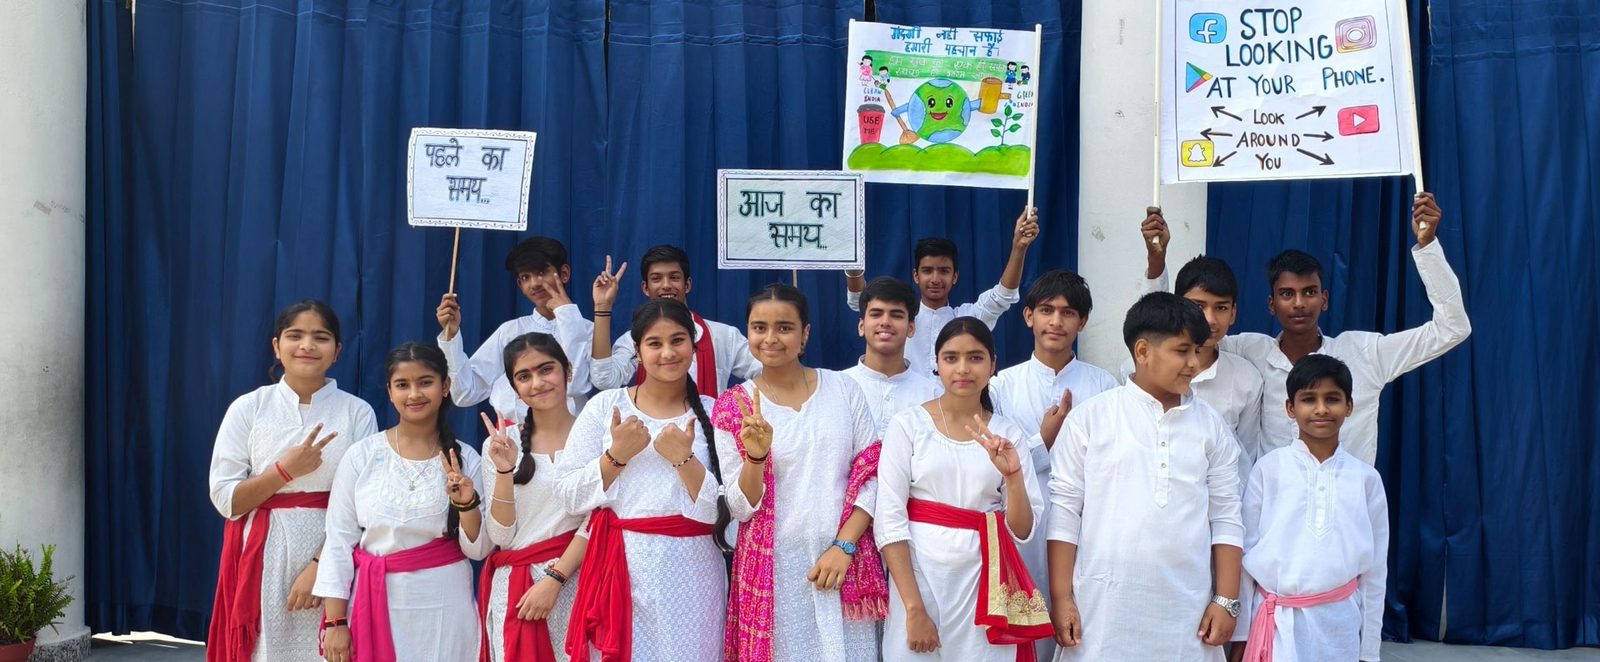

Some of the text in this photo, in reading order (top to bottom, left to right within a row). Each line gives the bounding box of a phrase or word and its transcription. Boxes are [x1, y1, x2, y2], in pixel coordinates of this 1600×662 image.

[1240, 6, 1303, 40] STOP
[904, 37, 933, 53] हमारी
[945, 44, 978, 57] पहचान
[1226, 35, 1333, 67] LOOKING
[1206, 66, 1385, 99] AT YOUR PHONE.
[863, 116, 880, 125] USE
[1253, 109, 1285, 125] LOOK
[1236, 131, 1301, 148] AROUND
[425, 137, 510, 171] पहले का
[1255, 153, 1282, 170] YOU
[739, 190, 842, 218] आज का
